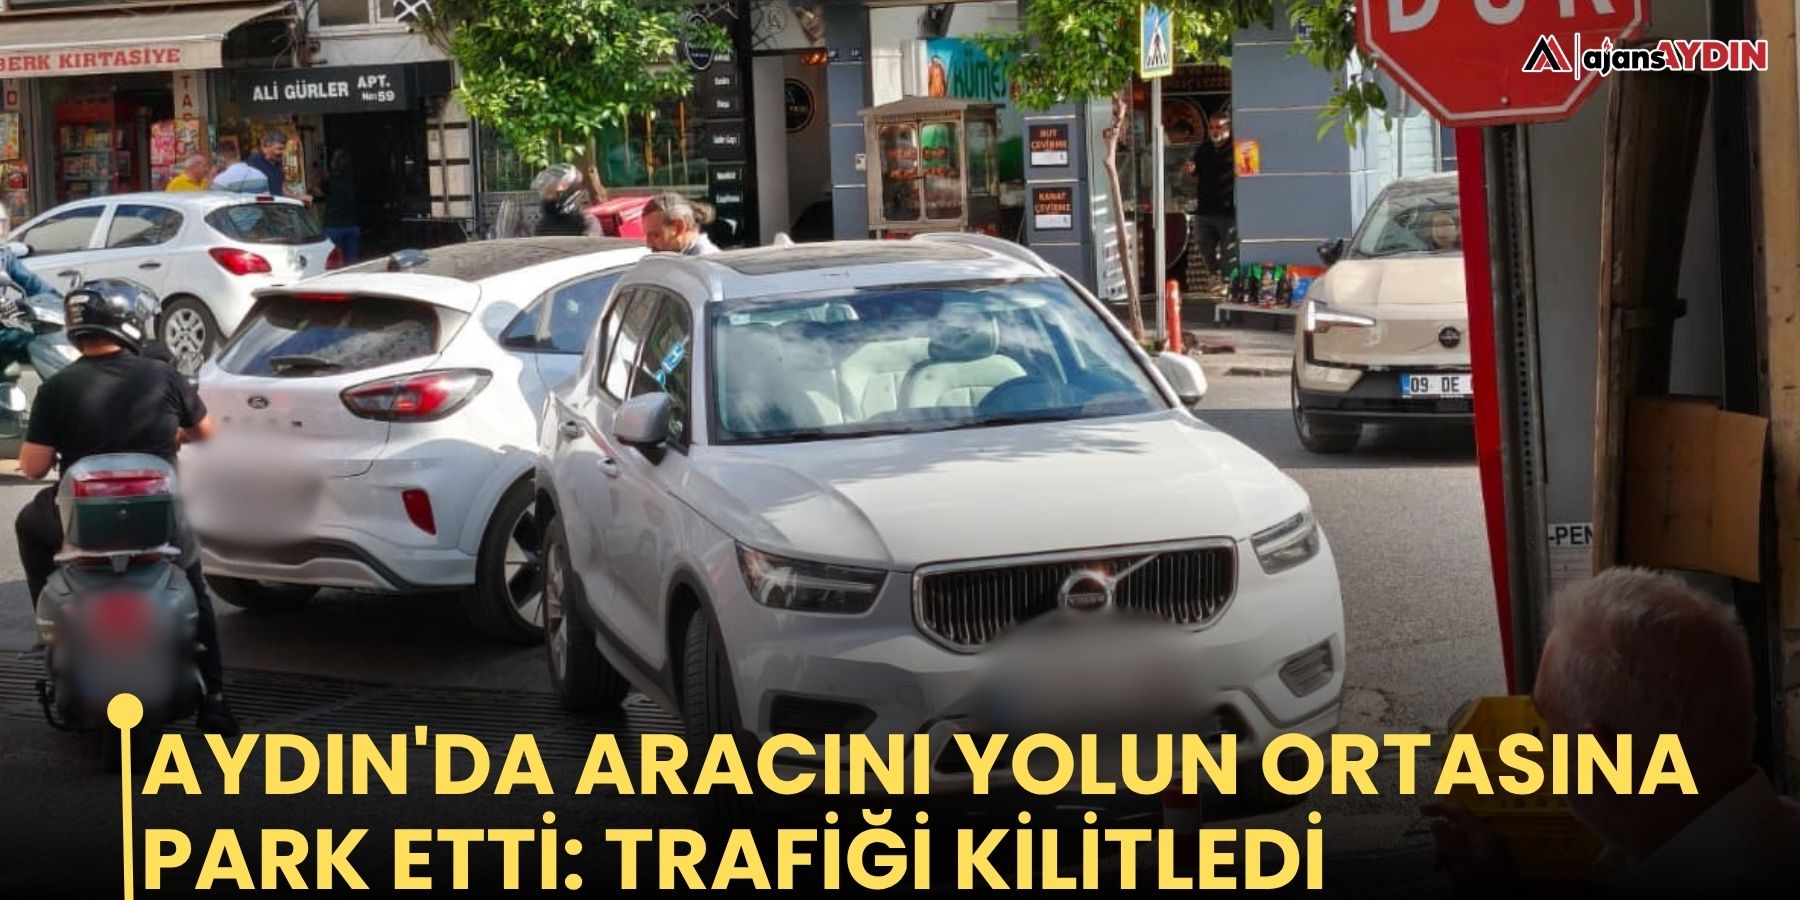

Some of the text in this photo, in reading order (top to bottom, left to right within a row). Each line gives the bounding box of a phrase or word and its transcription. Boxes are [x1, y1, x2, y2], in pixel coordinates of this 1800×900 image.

[58, 47, 182, 69] KIRTASİYE
[253, 74, 391, 101] ALİ GÜRLER APT.
[1410, 376, 1459, 393] 09 DE
